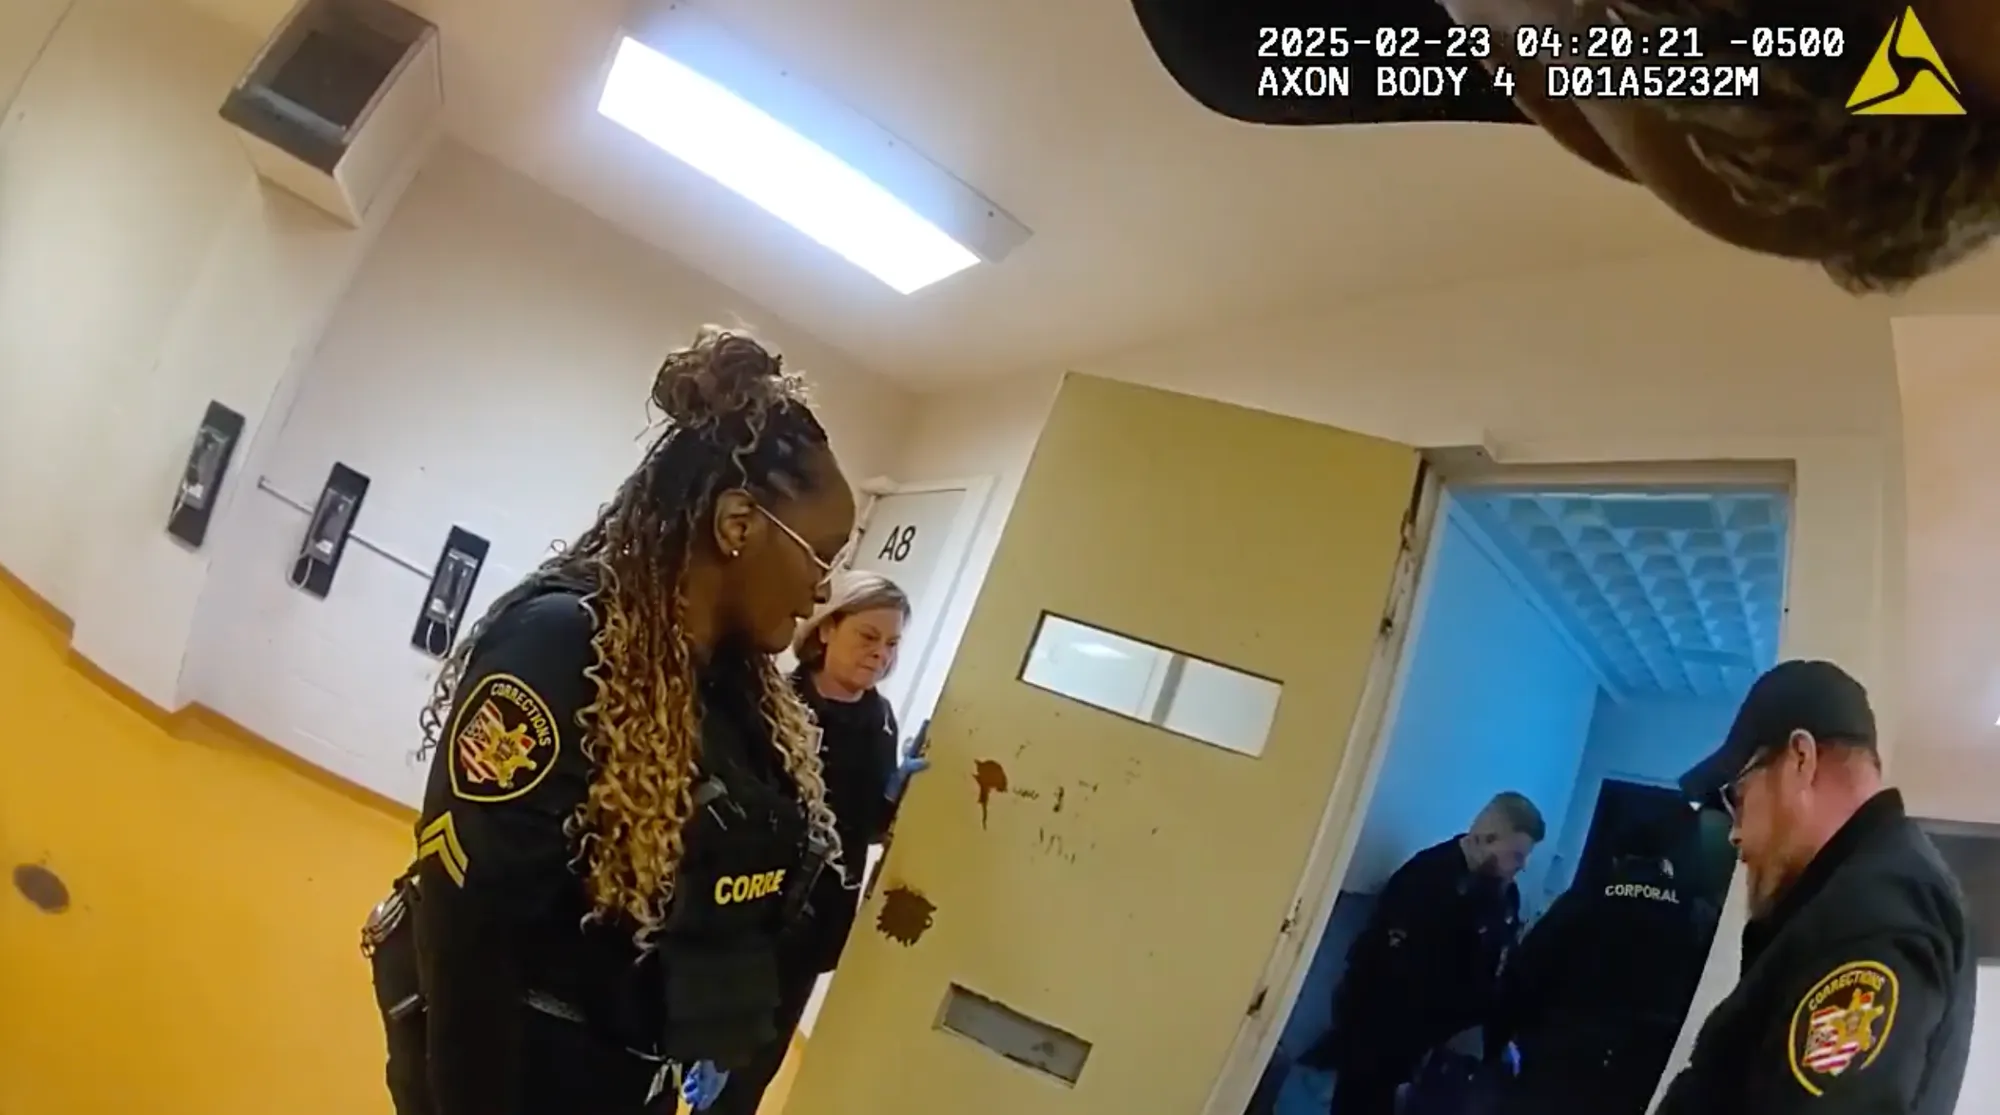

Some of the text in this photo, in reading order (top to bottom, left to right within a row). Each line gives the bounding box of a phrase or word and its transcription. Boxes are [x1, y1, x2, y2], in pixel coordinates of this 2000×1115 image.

[878, 525, 916, 562] A8
[490, 683, 551, 747] CORRECTIONS
[1604, 884, 1680, 904] CORPORAL
[1808, 970, 1885, 1010] CORRECTIONS
